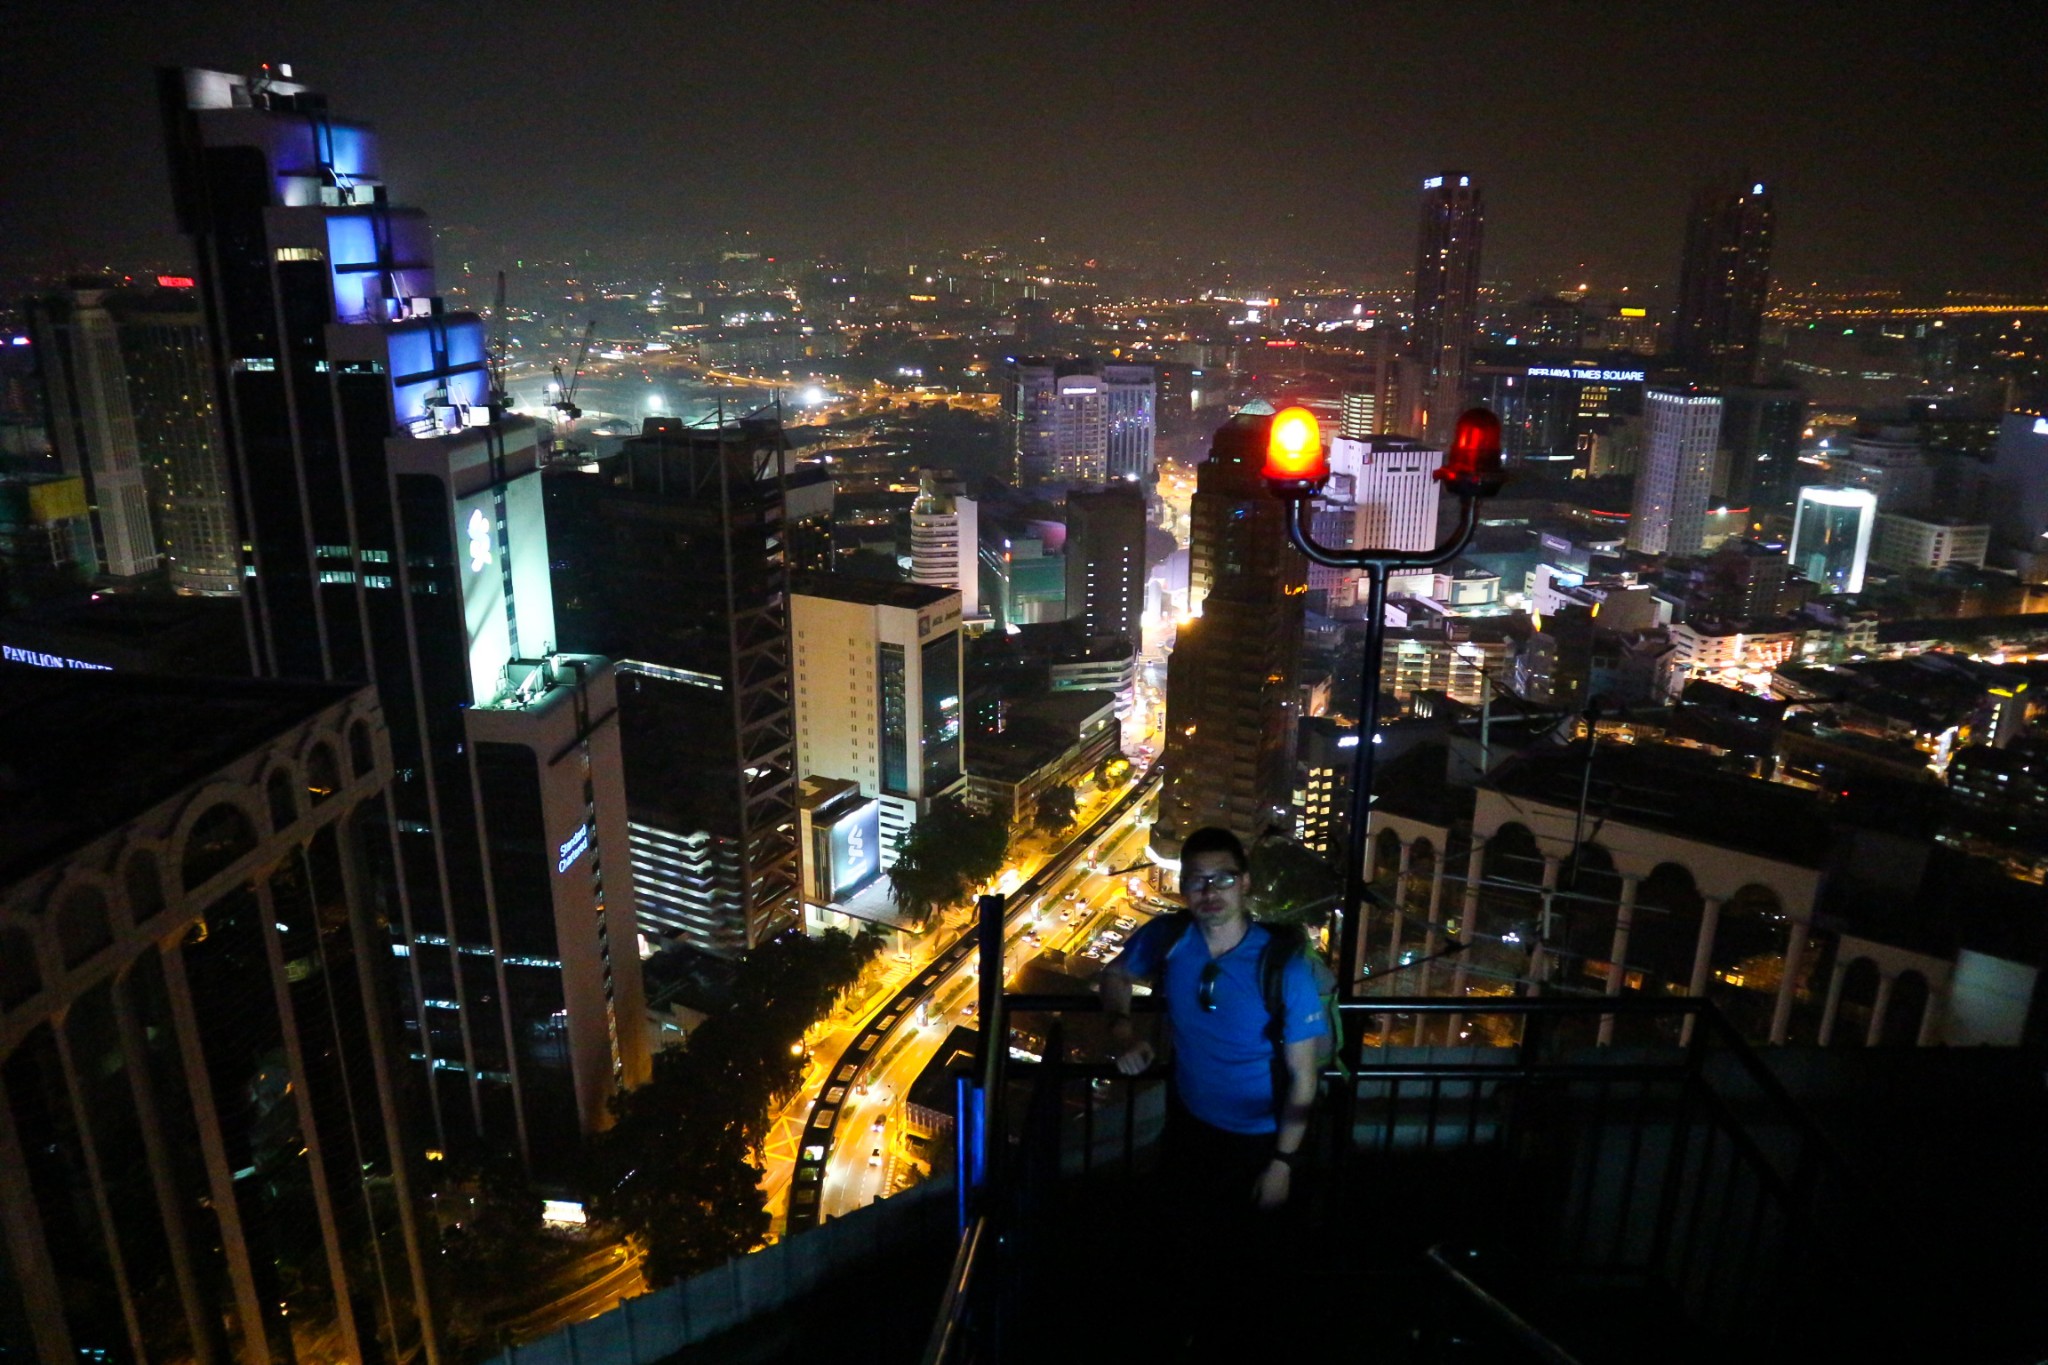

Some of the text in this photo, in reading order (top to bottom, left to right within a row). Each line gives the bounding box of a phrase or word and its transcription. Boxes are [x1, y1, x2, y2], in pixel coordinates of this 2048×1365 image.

[1572, 369, 1602, 380] TIMES
[1603, 370, 1645, 381] SQUARE
[2, 645, 64, 668] PAVILION
[560, 824, 586, 857] Standard
[559, 837, 587, 873] Chartered
